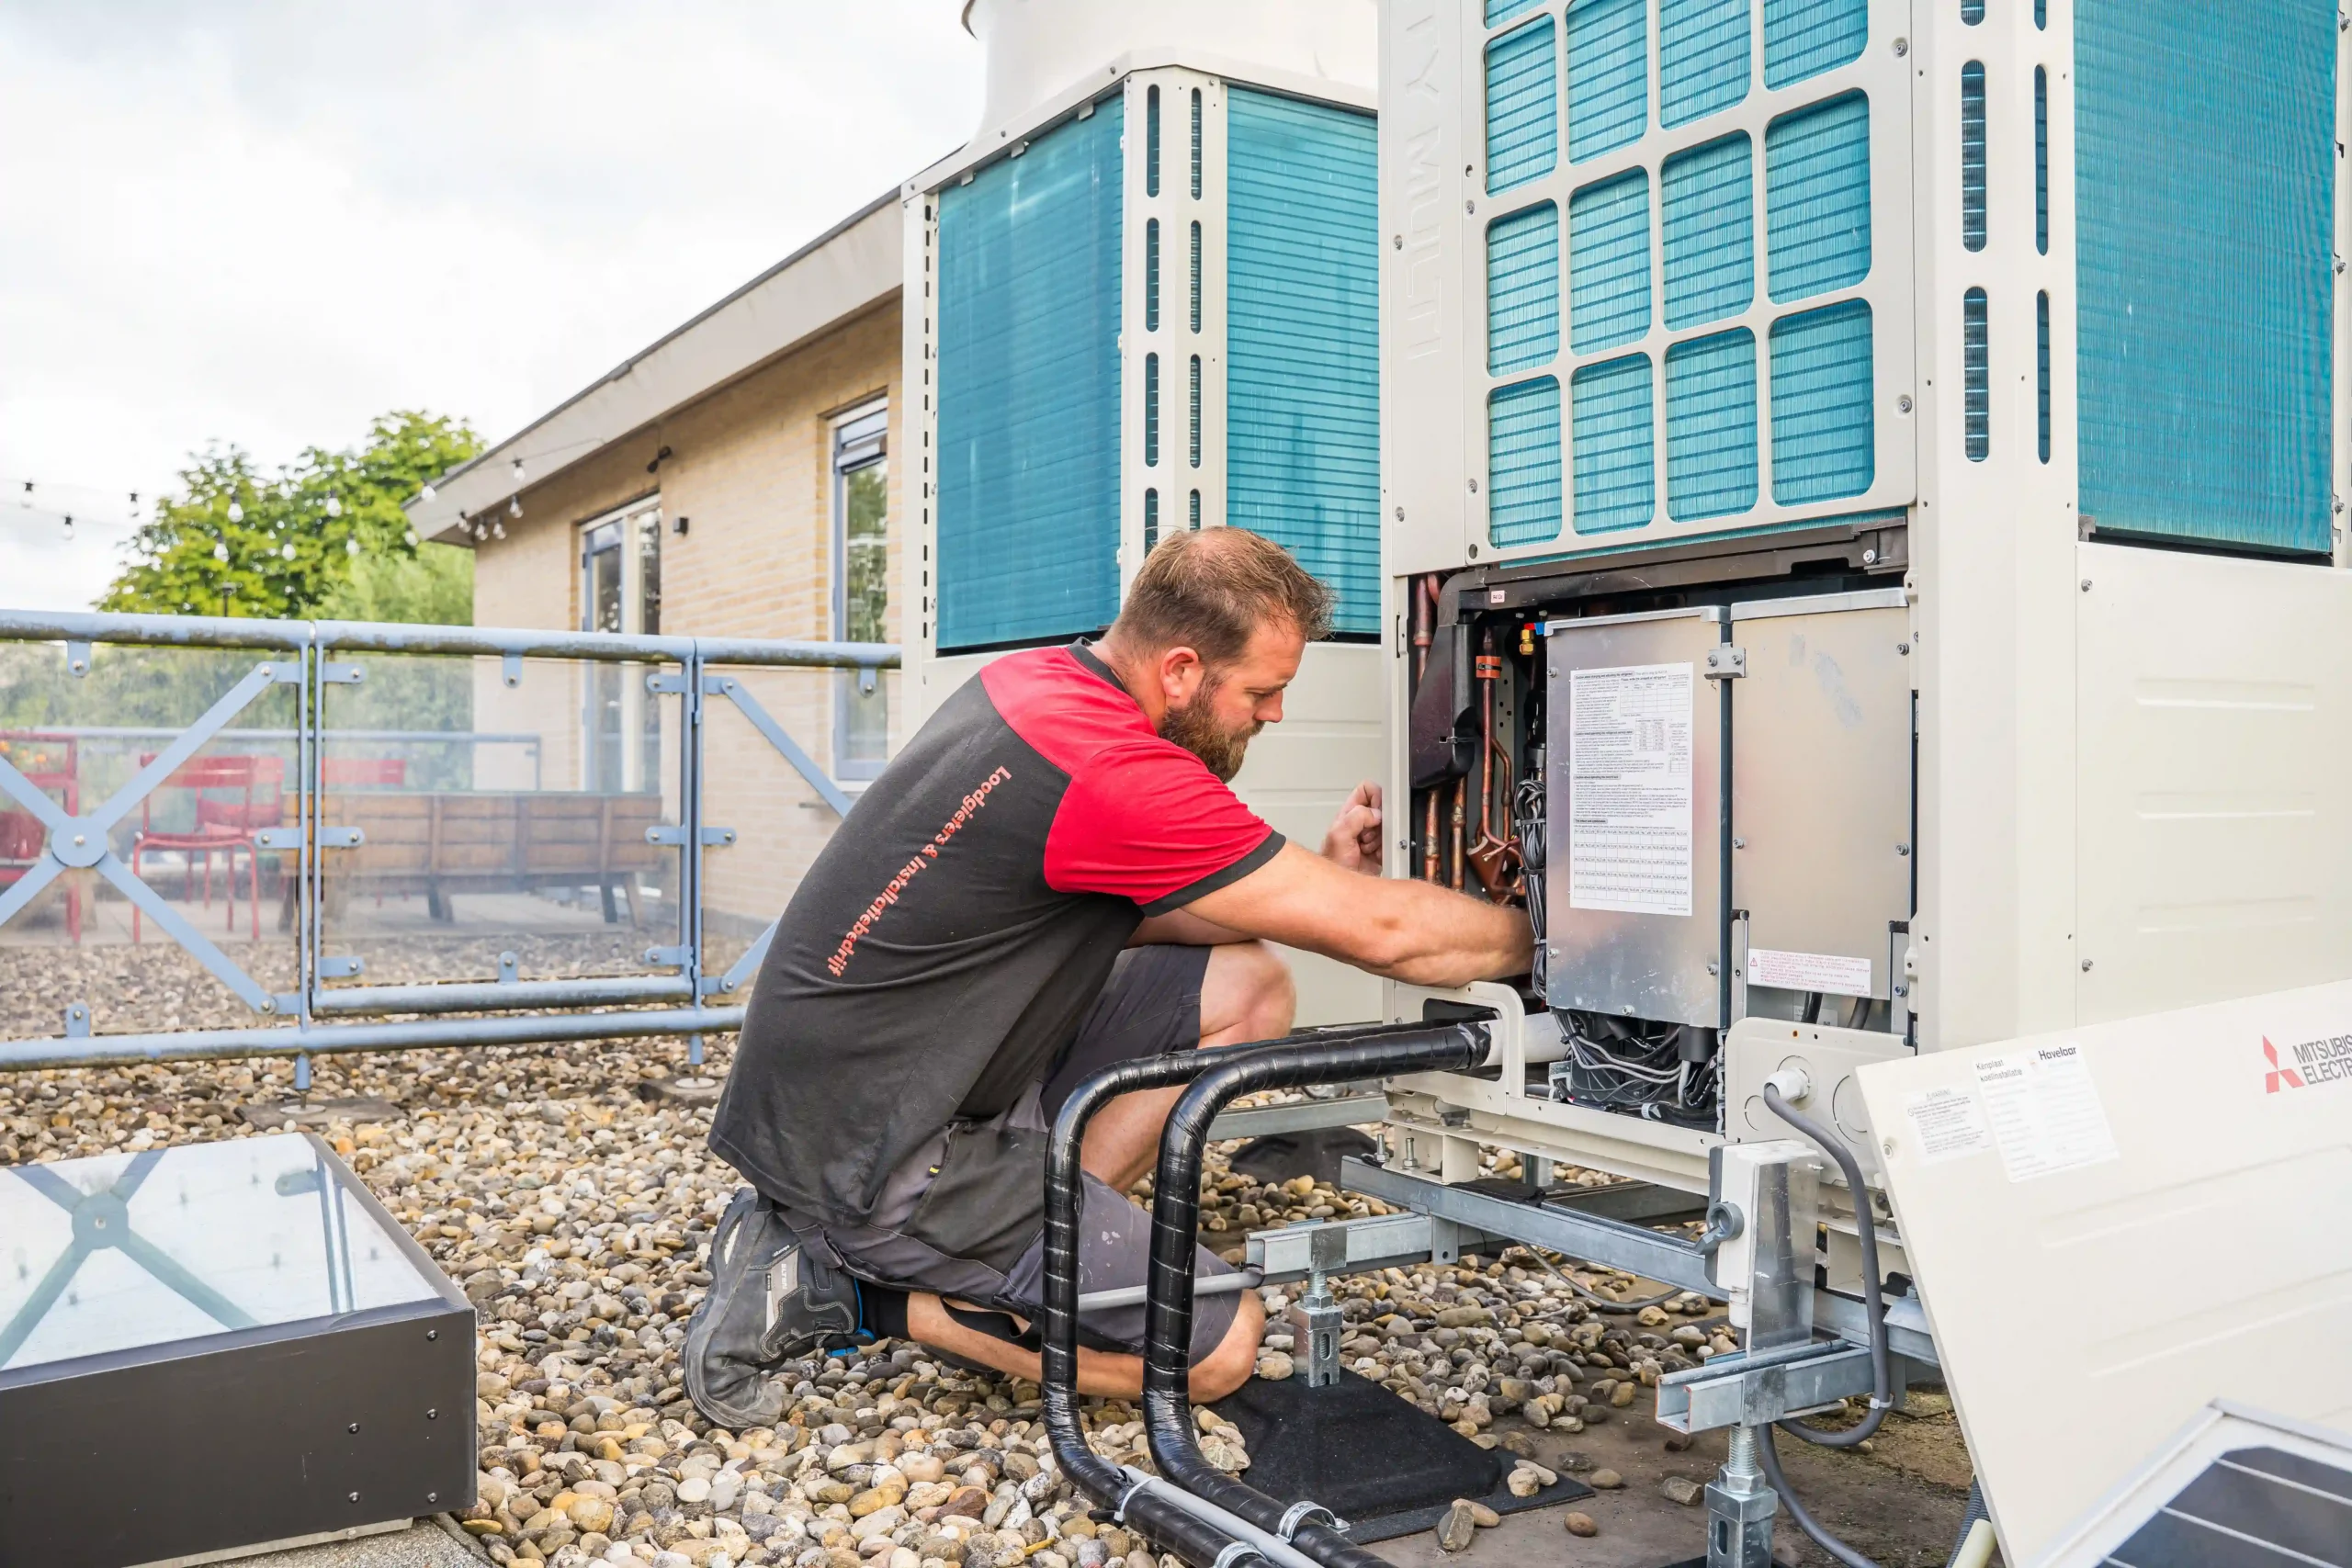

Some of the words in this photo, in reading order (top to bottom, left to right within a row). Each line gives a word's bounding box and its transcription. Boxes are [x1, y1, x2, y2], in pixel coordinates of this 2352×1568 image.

[1406, 124, 1442, 360] MULTI
[934, 765, 1012, 846] Loodgieters
[921, 842, 938, 859] &
[827, 855, 928, 977] Installatiebedrijf
[1975, 1059, 2004, 1072] Kenplaat
[2038, 1045, 2076, 1061] Havelaar
